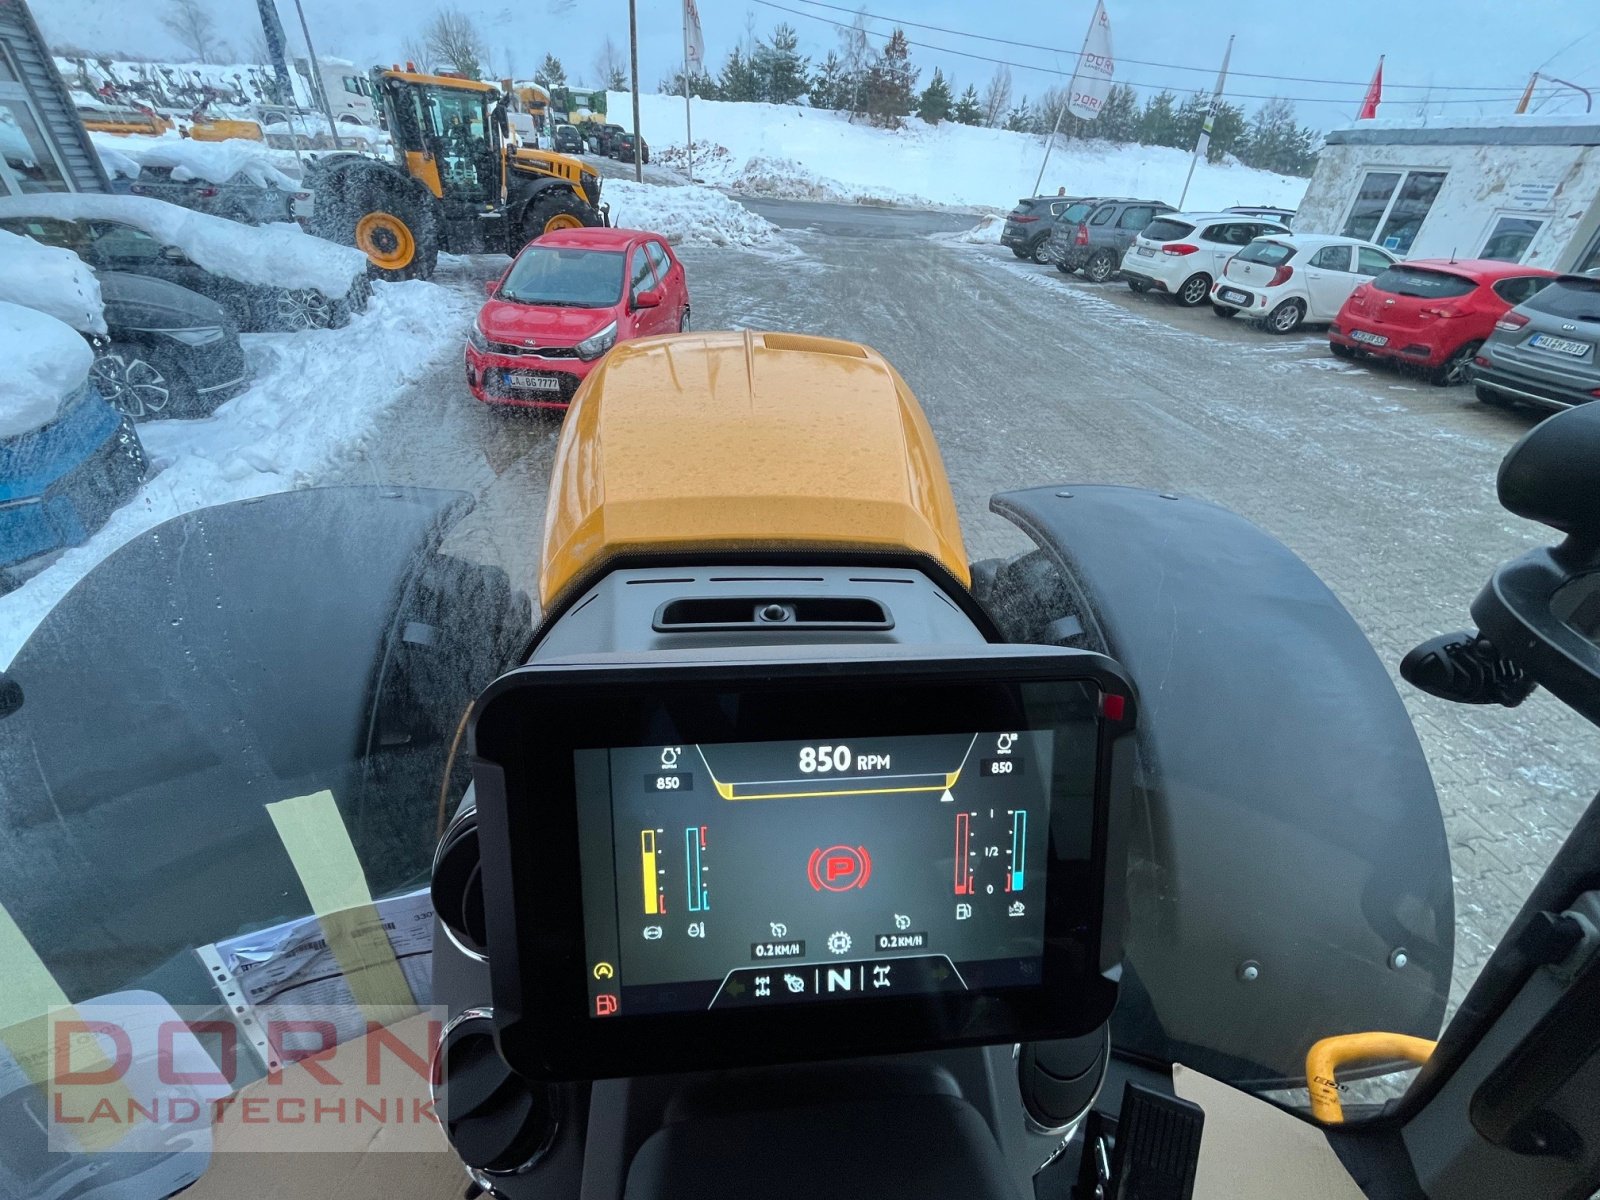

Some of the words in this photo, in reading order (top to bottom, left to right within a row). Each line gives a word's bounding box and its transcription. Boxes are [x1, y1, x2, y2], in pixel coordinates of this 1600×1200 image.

[1086, 53, 1114, 71] DOR
[799, 745, 852, 773] 850
[857, 754, 891, 771] RPM
[991, 761, 1013, 774] 850
[656, 776, 680, 790] 850
[984, 846, 999, 858] 1/2
[986, 884, 994, 895] 0
[827, 968, 851, 993] N
